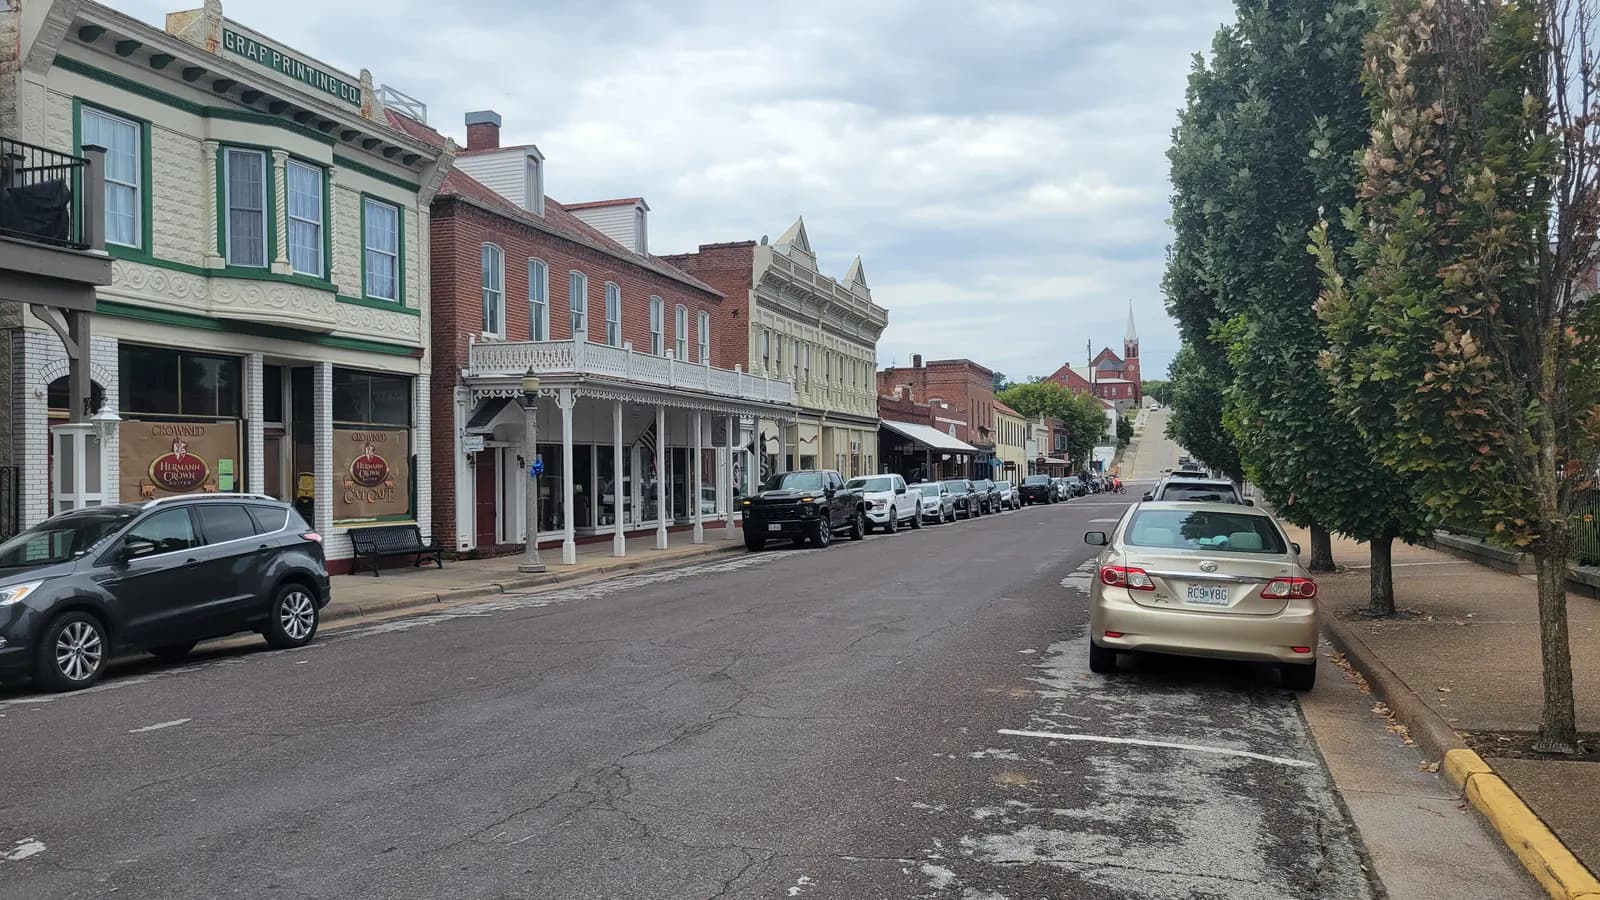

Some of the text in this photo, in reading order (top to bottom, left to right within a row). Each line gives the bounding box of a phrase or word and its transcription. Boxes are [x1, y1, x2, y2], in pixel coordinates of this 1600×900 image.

[225, 31, 361, 104] GRAF PRINTING CO.
[152, 424, 205, 437] CROWNED
[160, 461, 200, 473] HERMANN
[163, 471, 196, 481] CROWN
